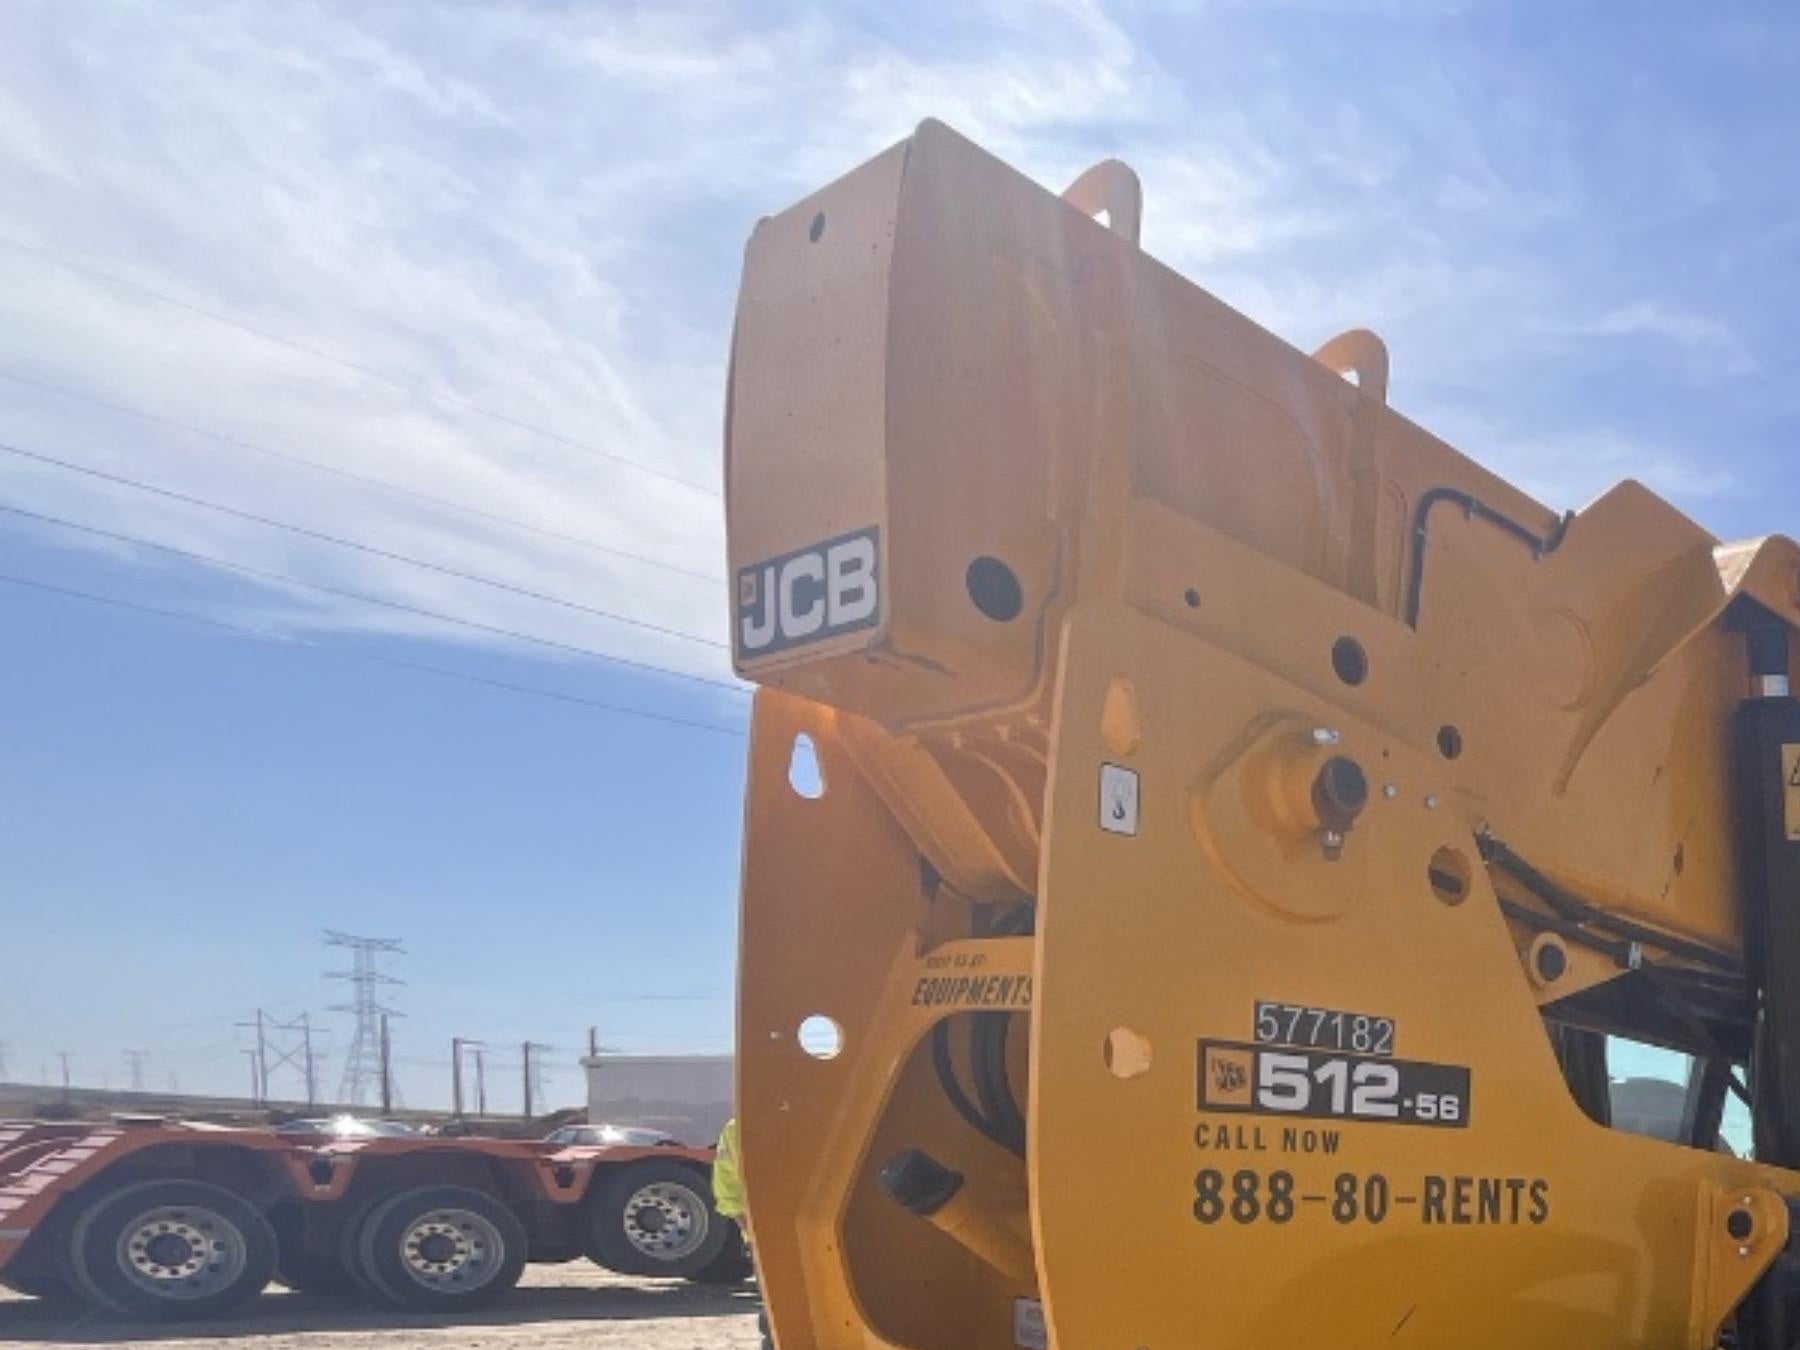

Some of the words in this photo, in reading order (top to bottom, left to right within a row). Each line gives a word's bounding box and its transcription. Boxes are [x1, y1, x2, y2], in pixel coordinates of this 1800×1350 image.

[742, 536, 878, 649] JCB
[1256, 1003, 1394, 1054] 577182
[1194, 1124, 1267, 1151] CALL
[1283, 1128, 1340, 1155] NOW
[1193, 1169, 1549, 1226] 888-80-RENTS
